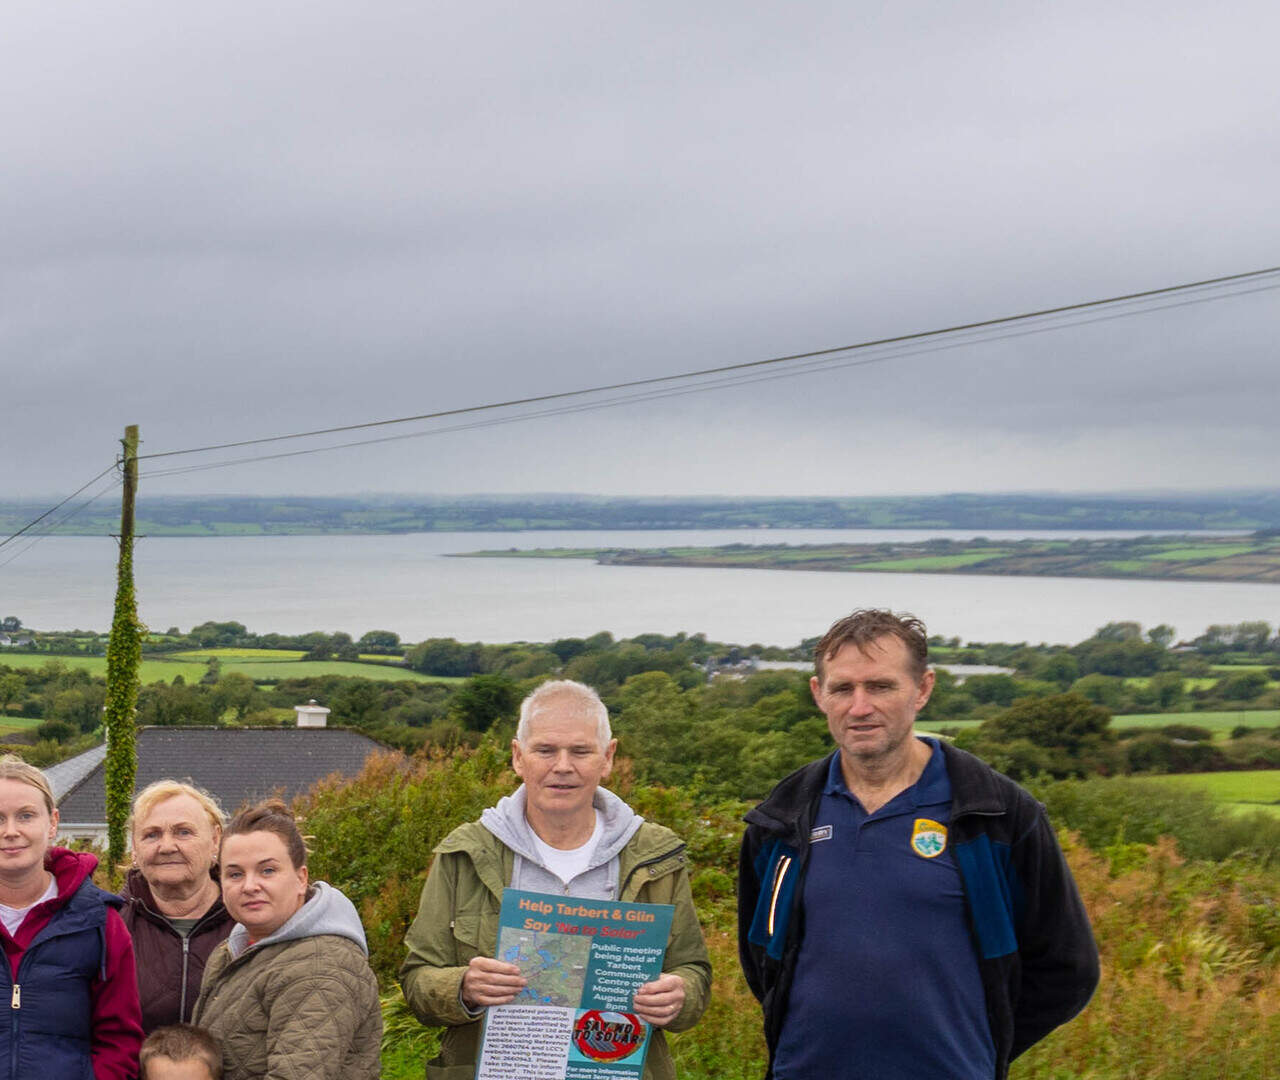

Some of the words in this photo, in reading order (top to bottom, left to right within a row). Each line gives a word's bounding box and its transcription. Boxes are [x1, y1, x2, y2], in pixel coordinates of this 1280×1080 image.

[519, 900, 552, 914] Help
[556, 904, 608, 918] Tarbert
[612, 909, 622, 919] &
[626, 910, 654, 921] Glin
[524, 919, 551, 932] Say
[582, 926, 596, 934] to
[592, 943, 621, 951] Public
[623, 946, 661, 955] meeting
[595, 952, 621, 961] being
[607, 962, 641, 970] Tarbert
[595, 969, 650, 980] Community
[592, 985, 630, 994] Monday
[594, 994, 628, 1003] August
[584, 1021, 608, 1030] SAY
[615, 1023, 634, 1033] NO
[574, 1030, 590, 1039] TO
[595, 1031, 639, 1044] SOLAR
